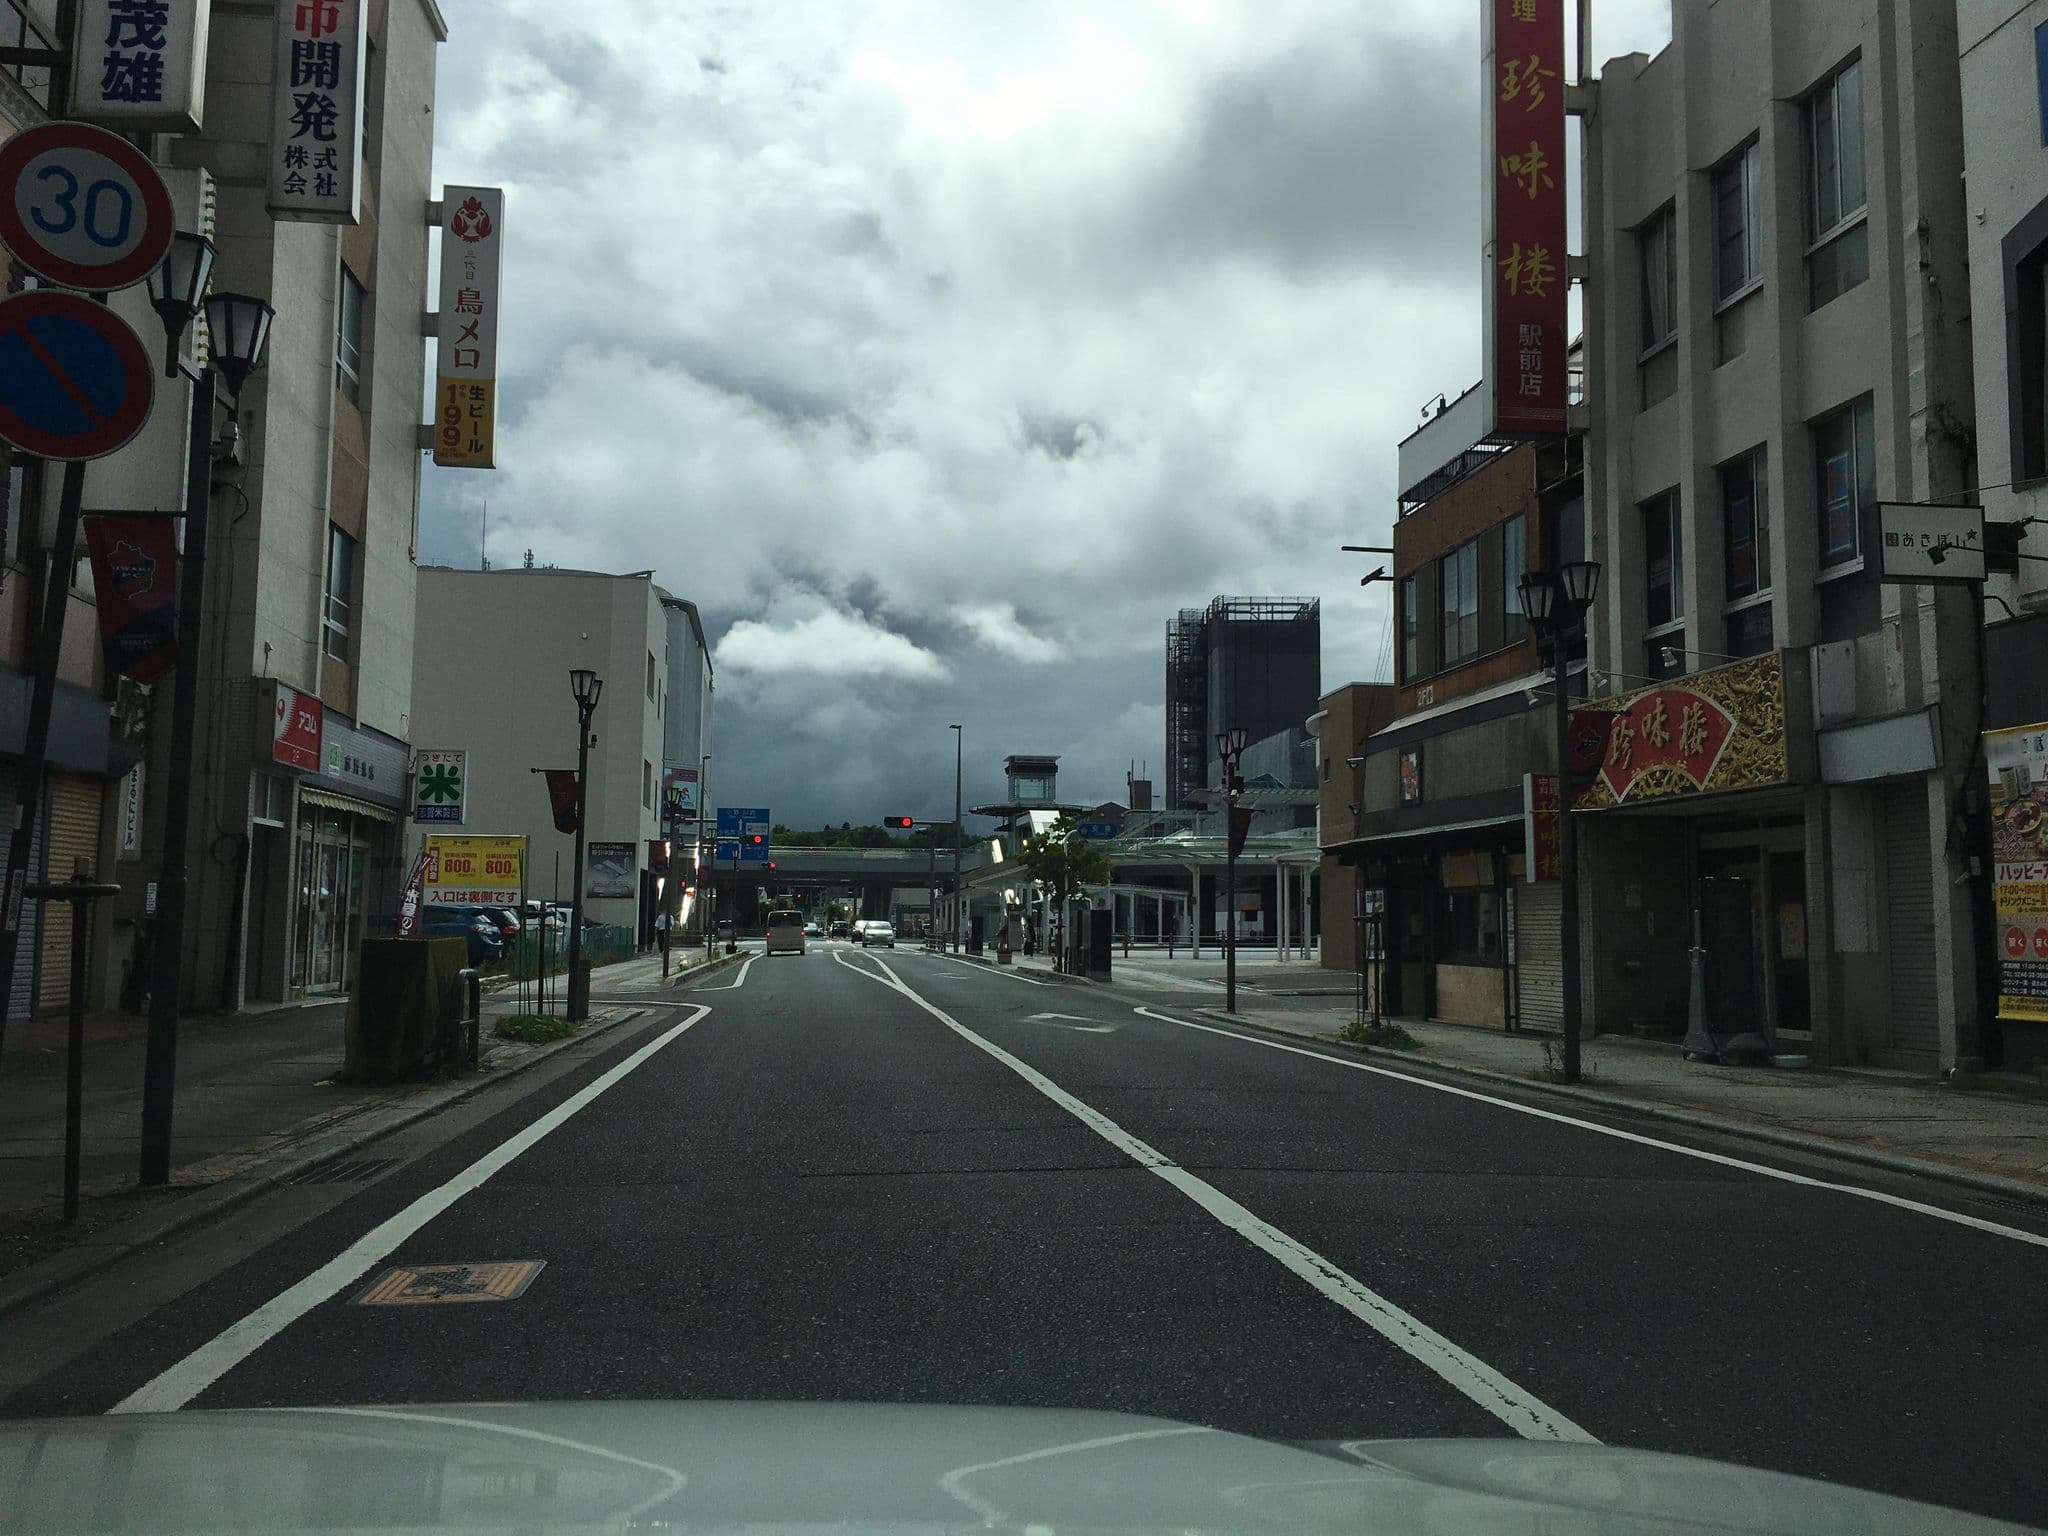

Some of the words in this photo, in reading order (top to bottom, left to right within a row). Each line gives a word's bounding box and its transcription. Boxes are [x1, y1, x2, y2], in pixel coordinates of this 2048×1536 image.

[101, 0, 169, 104] 茂雄
[30, 166, 133, 248] 30
[1500, 54, 1556, 298] 珍味楼
[454, 287, 484, 370] 鳥メロ
[1519, 323, 1543, 398] 駅前店
[442, 384, 463, 447] 199
[467, 385, 486, 454] 生ビール
[299, 710, 317, 735] アコム
[422, 753, 463, 763] つきたて
[1610, 697, 1708, 770] 珍味楼
[418, 763, 461, 804] 米
[431, 891, 517, 904] 入口は裏側です
